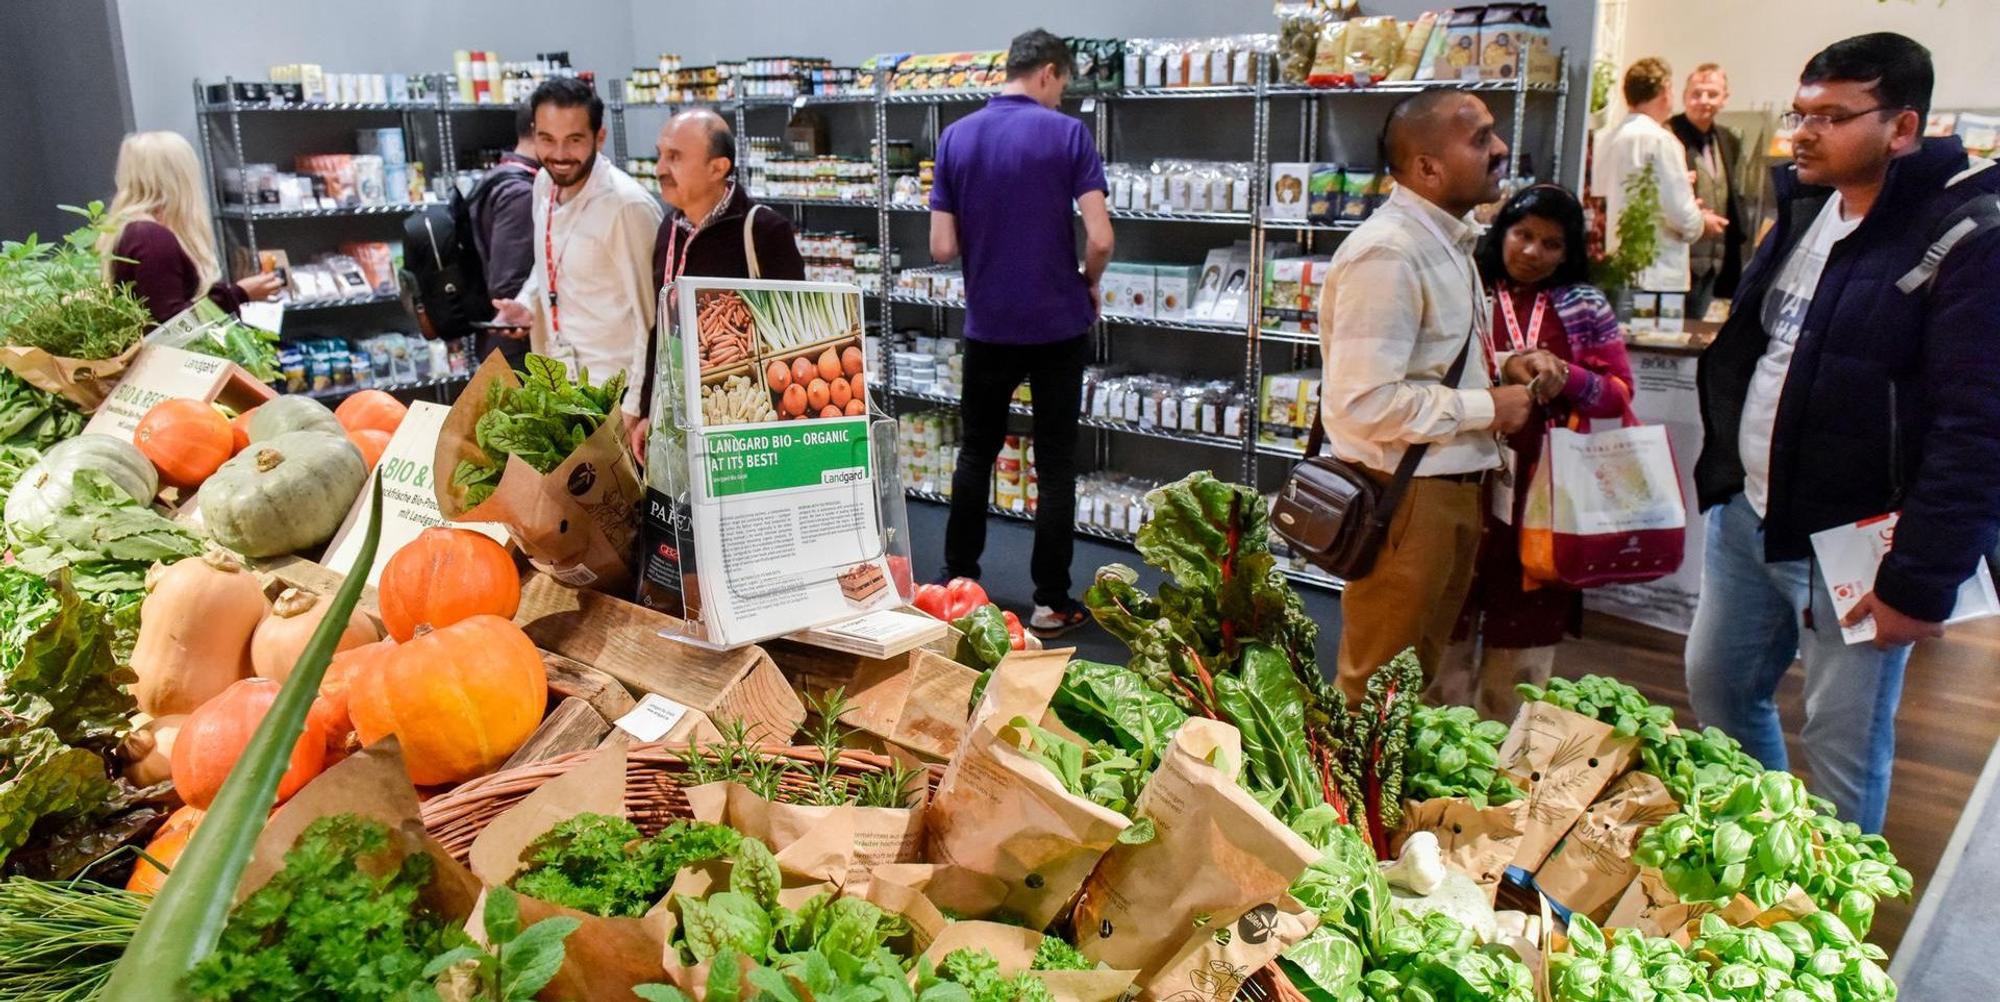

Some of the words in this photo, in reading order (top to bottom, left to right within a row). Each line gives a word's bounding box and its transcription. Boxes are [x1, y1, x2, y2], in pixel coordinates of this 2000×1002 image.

[708, 435, 769, 454] LANDGARD
[772, 434, 792, 449] BIO
[803, 429, 849, 446] ORGANIC
[384, 457, 415, 483] BIO
[413, 466, 428, 487] &
[711, 456, 725, 472] AT
[726, 456, 744, 470] ITS
[746, 452, 779, 467] BEST!
[823, 470, 863, 485] Landgard
[399, 509, 410, 519] mit
